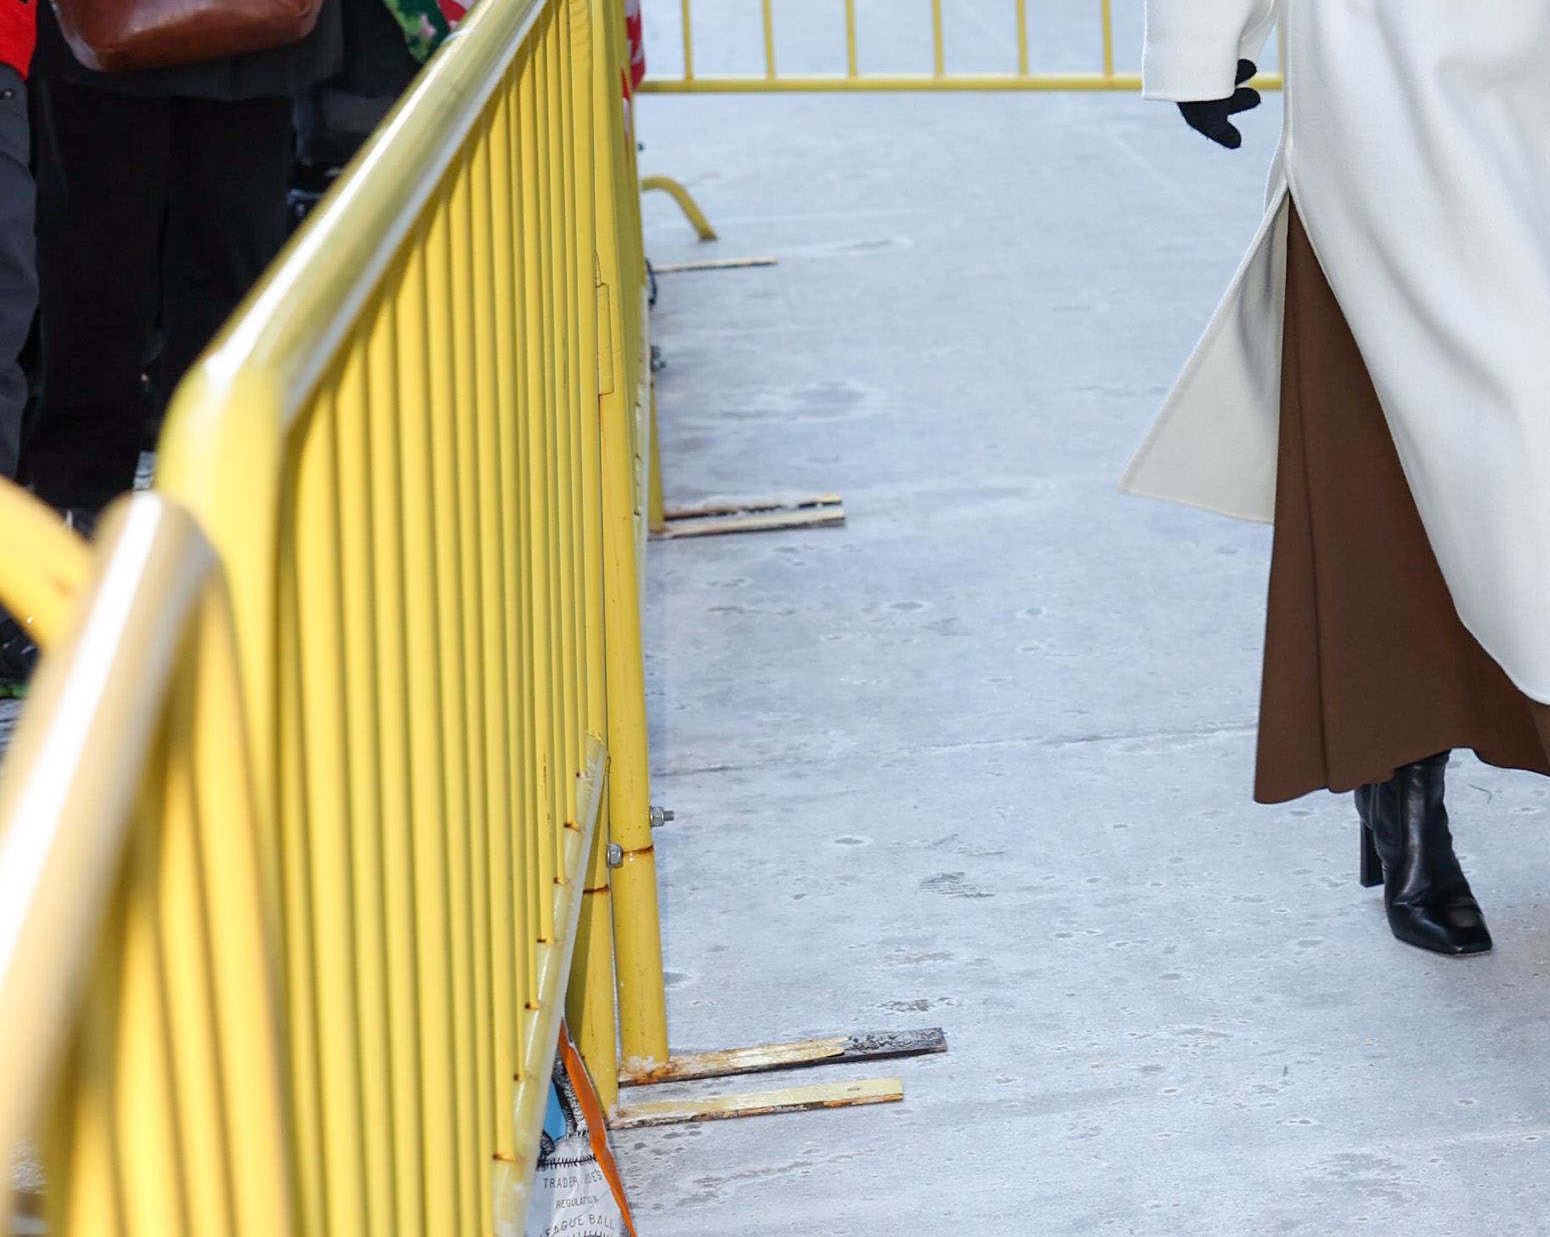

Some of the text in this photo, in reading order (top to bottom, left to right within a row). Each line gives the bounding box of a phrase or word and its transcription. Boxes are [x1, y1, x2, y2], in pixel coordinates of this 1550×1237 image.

[543, 1176, 579, 1189] TRADER
[556, 1195, 598, 1209] REGULATION
[540, 1213, 615, 1237] EAGUE BALL
